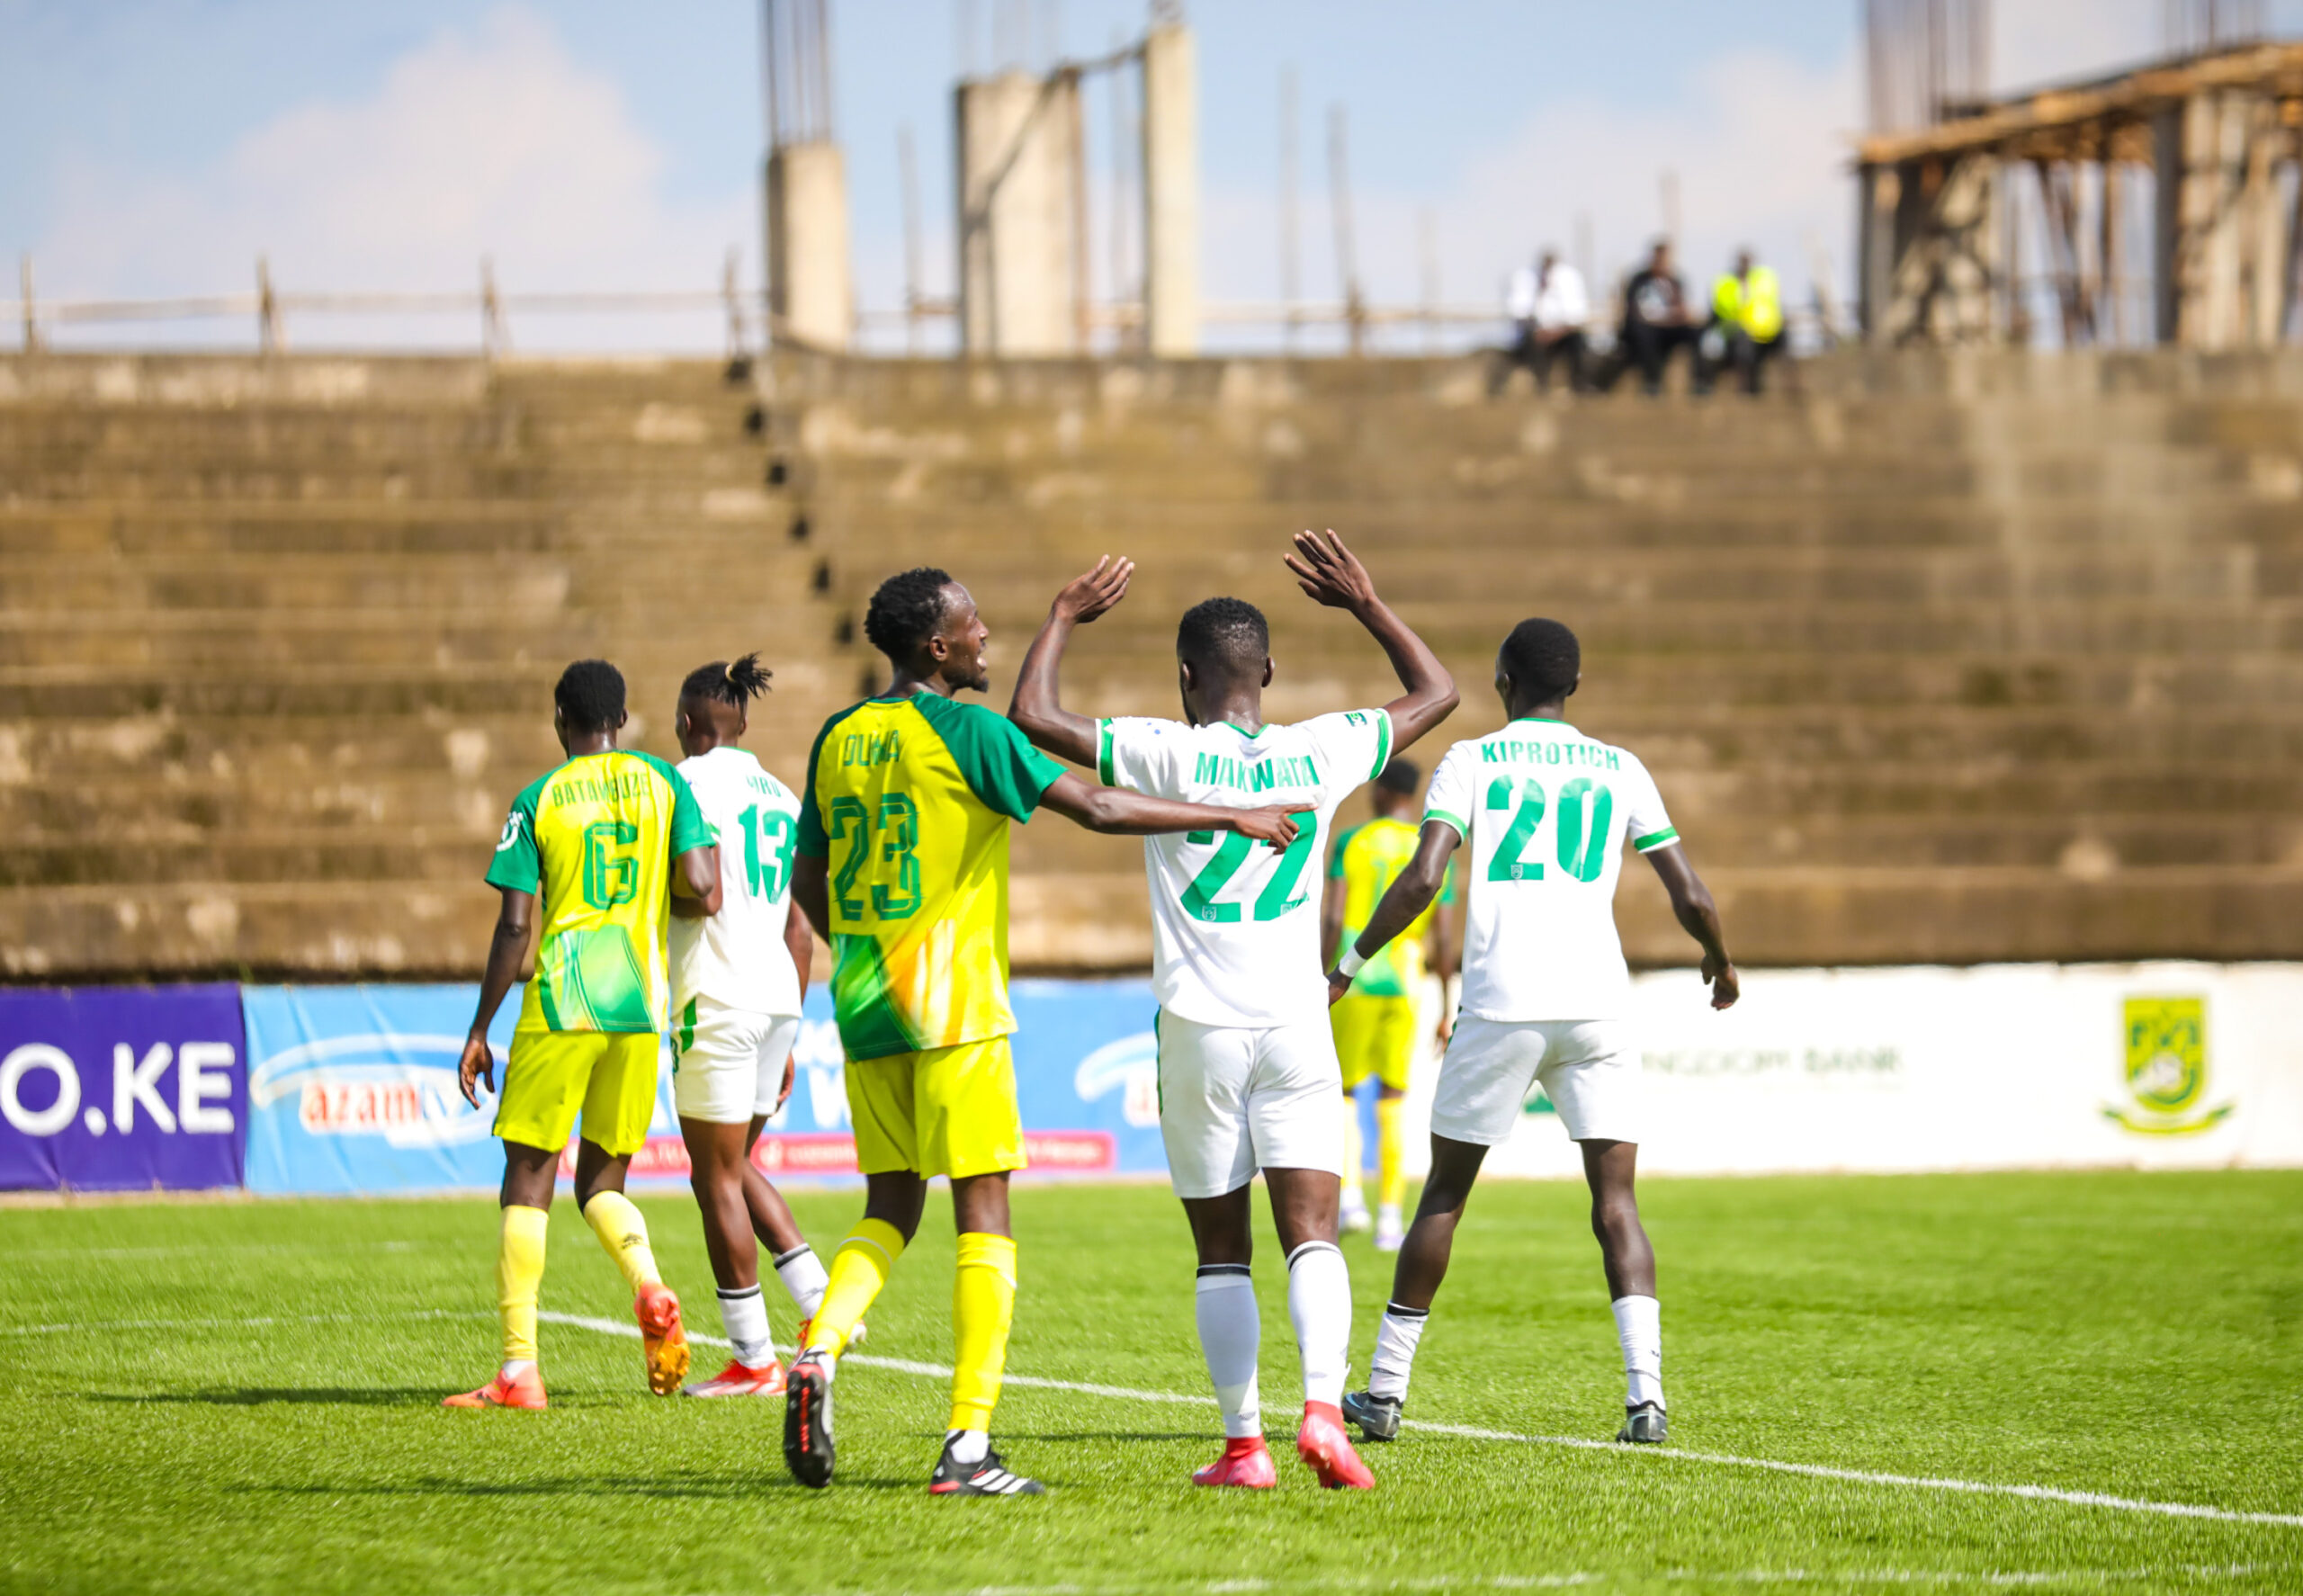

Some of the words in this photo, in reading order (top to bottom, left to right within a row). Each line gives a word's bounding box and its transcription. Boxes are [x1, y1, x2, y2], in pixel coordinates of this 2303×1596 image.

[551, 771, 650, 808] BATAMBUZE
[1194, 751, 1321, 794] MAKWATA
[1482, 740, 1620, 771] KIPROTICH
[583, 820, 639, 910] 6
[738, 802, 798, 905] 13
[829, 791, 927, 921] 23
[1180, 809, 1318, 923] 22
[1486, 774, 1612, 883] 20
